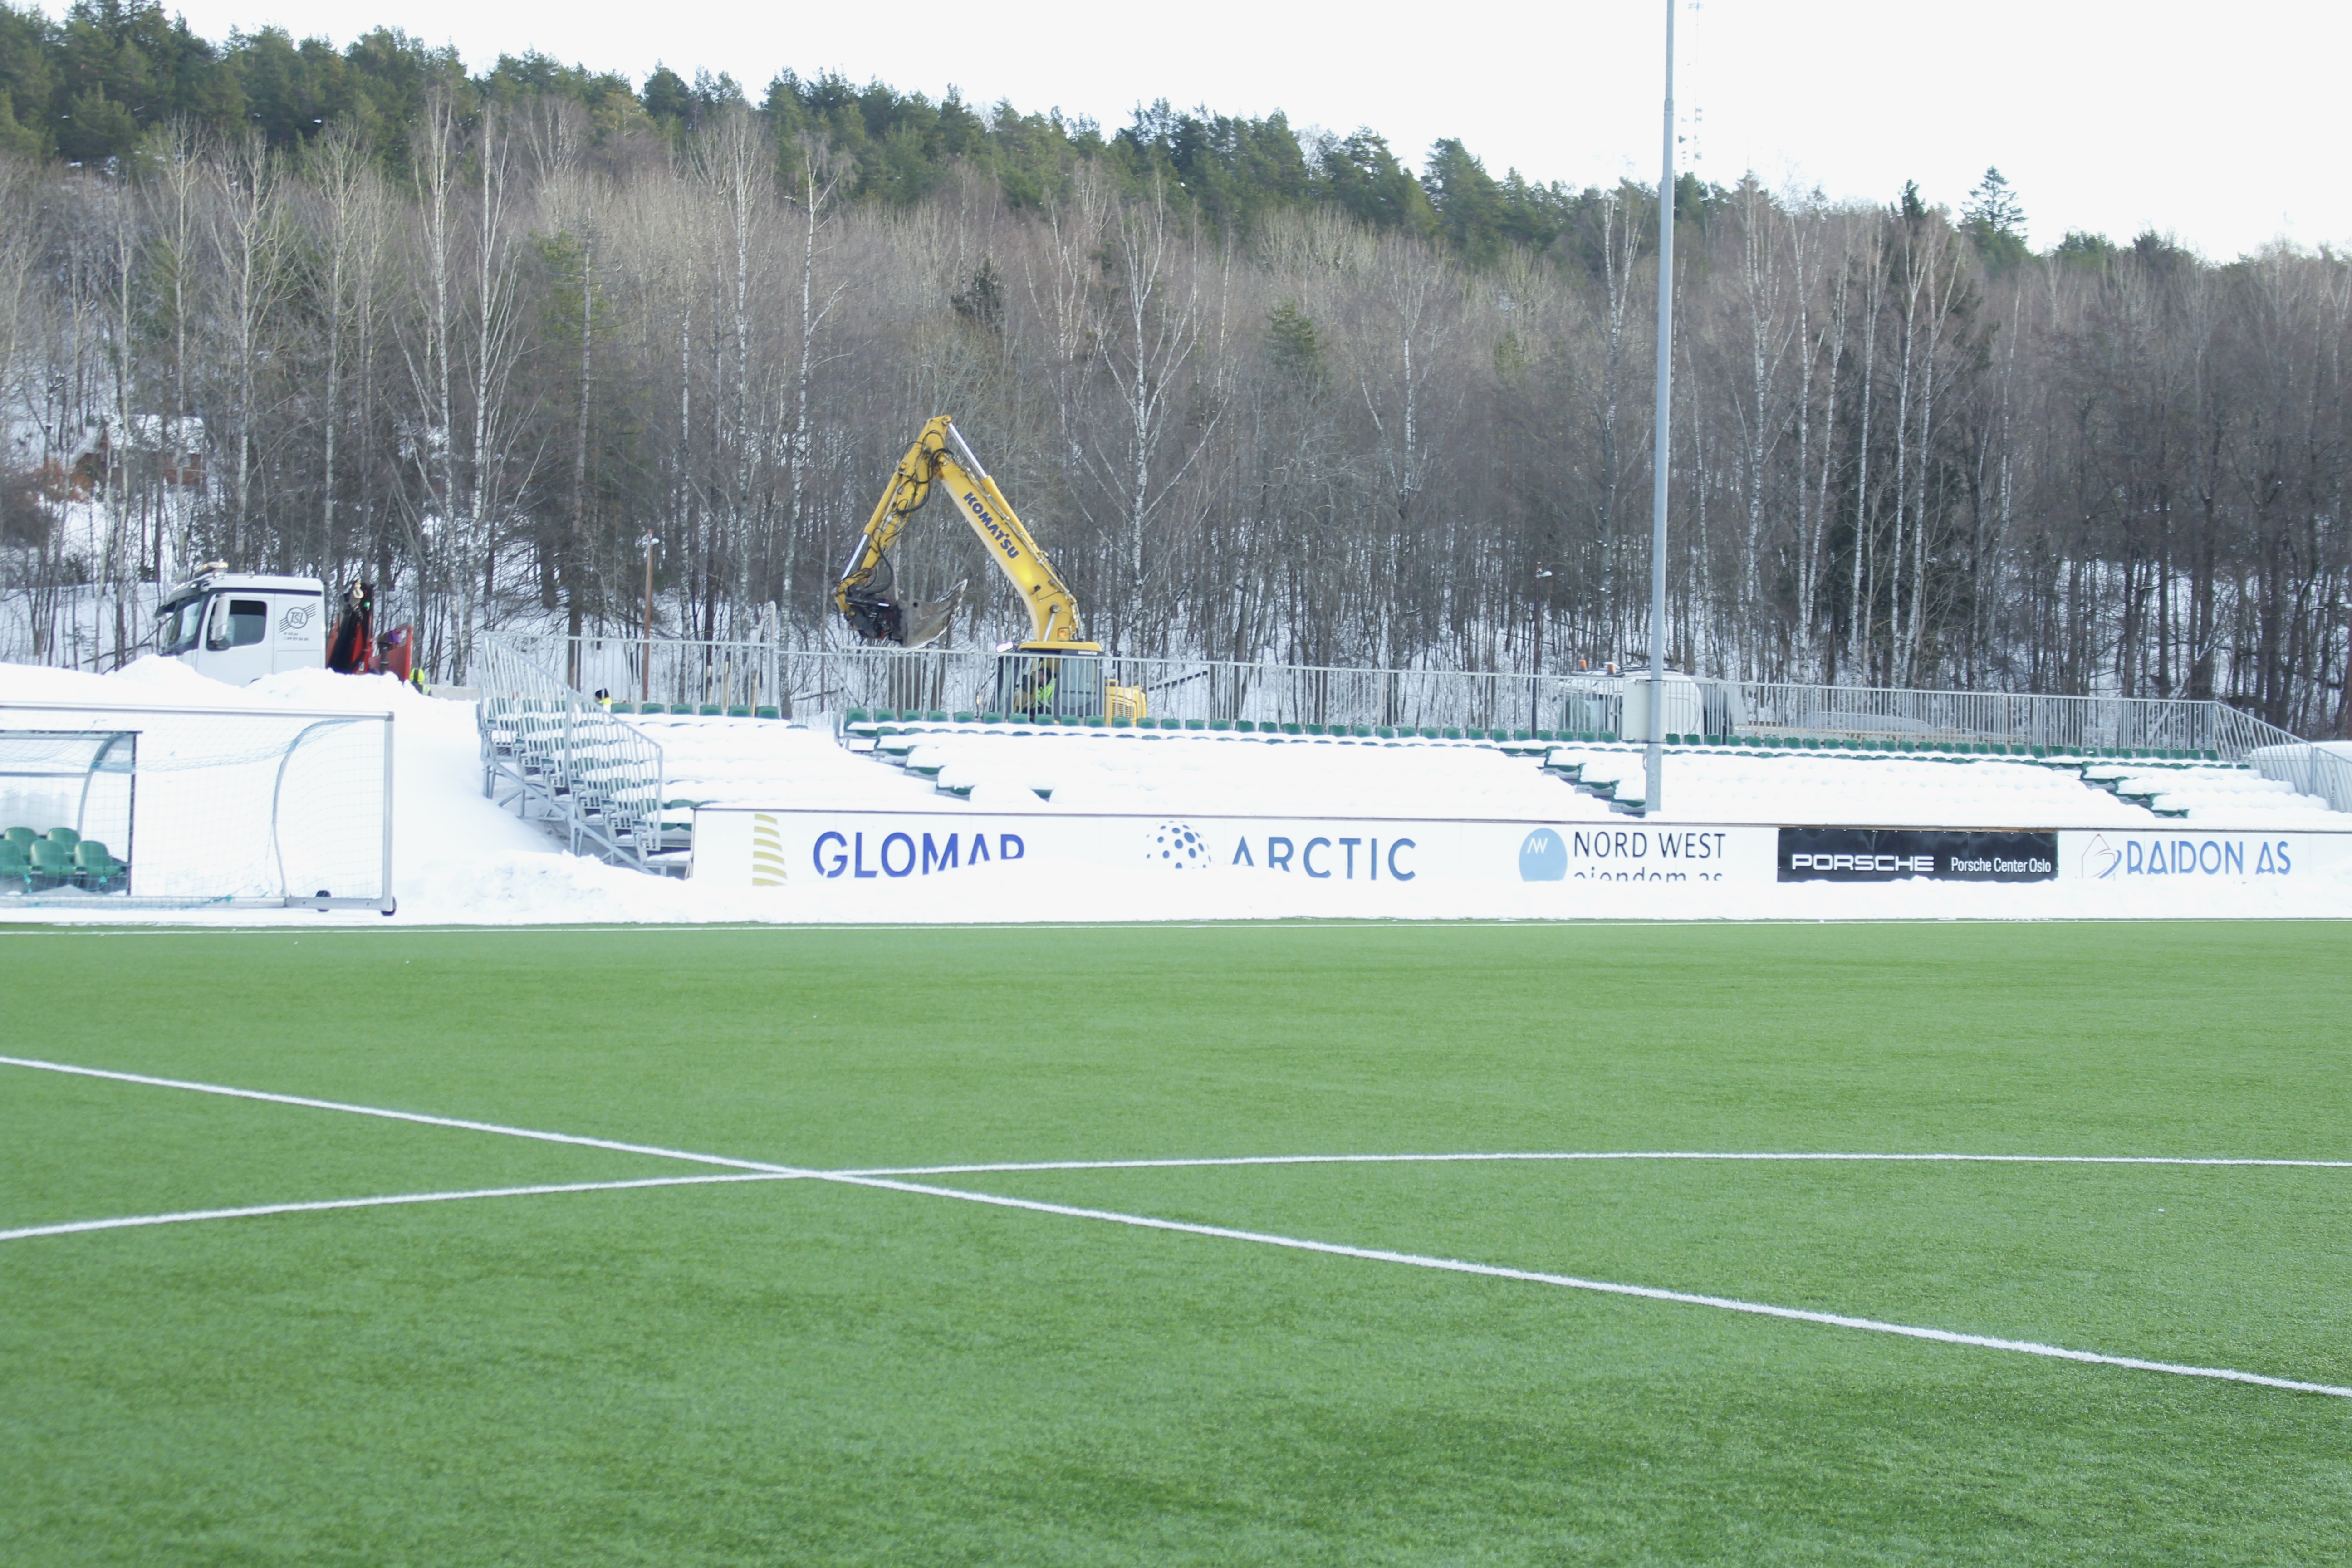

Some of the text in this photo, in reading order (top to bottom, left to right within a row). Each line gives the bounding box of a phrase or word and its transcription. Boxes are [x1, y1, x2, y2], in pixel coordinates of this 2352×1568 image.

[964, 492, 1020, 559] KOMATSU
[290, 611, 304, 624] TSL
[1232, 836, 1416, 882] ARCTIC
[1574, 831, 1726, 859] NORD WEST
[2127, 840, 2291, 876] RAIDON AS
[1792, 854, 1934, 872] PORSCHE
[1951, 857, 2051, 872] Porsche Center Oslo
